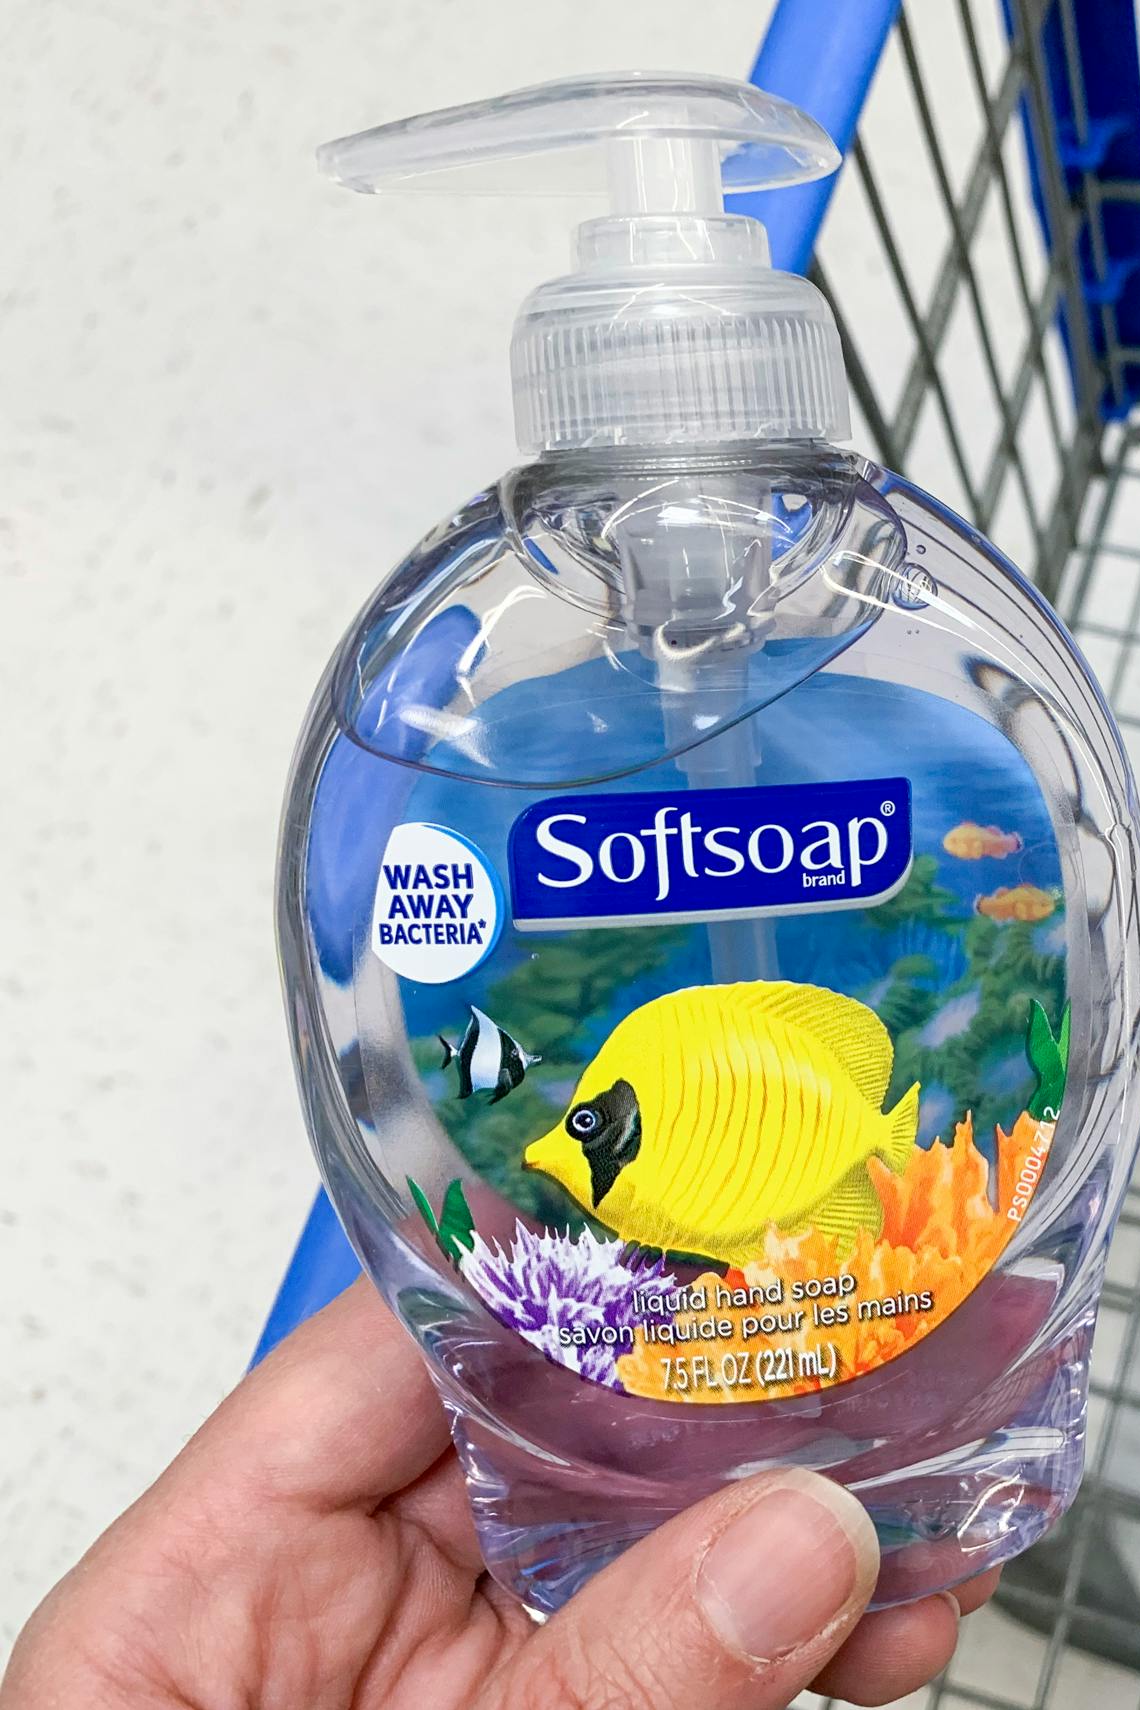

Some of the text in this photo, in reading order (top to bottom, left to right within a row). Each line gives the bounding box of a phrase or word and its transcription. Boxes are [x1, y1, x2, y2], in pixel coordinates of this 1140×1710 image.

[383, 863, 474, 890] WASH
[802, 869, 846, 888] brand
[388, 893, 474, 920] AWAY
[633, 1274, 856, 1317] liquid hand soap
[559, 1289, 933, 1347] savon liquide pour les mains
[691, 1354, 719, 1388] FL
[720, 1351, 752, 1386] OZ
[755, 1346, 795, 1387] (221
[799, 1341, 837, 1379] mL)
